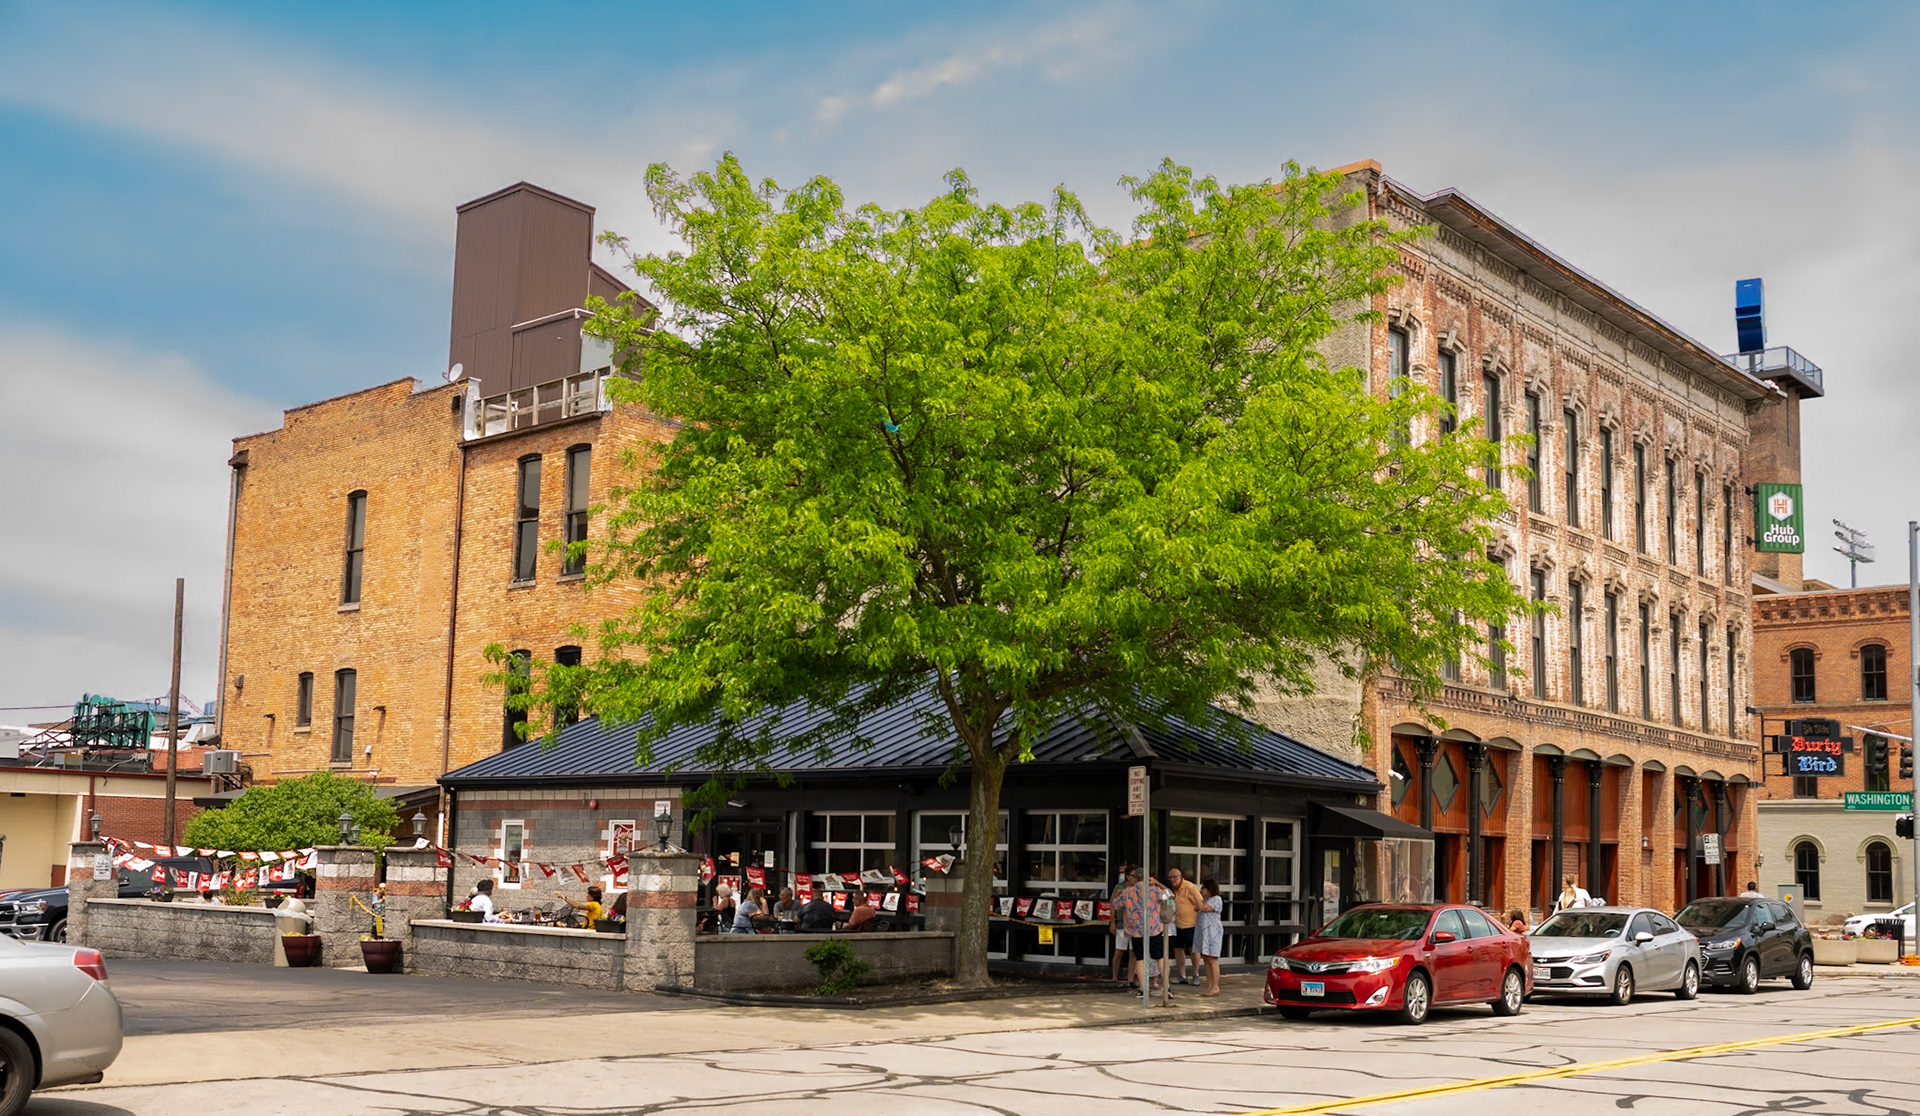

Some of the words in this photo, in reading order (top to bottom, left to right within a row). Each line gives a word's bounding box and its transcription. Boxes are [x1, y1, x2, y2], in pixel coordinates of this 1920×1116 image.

[1770, 524, 1795, 535] Hub
[1763, 532, 1800, 545] Group
[1791, 736, 1842, 756] Durty
[1797, 756, 1837, 771] Bird
[1846, 793, 1910, 805] WASHINGTON
